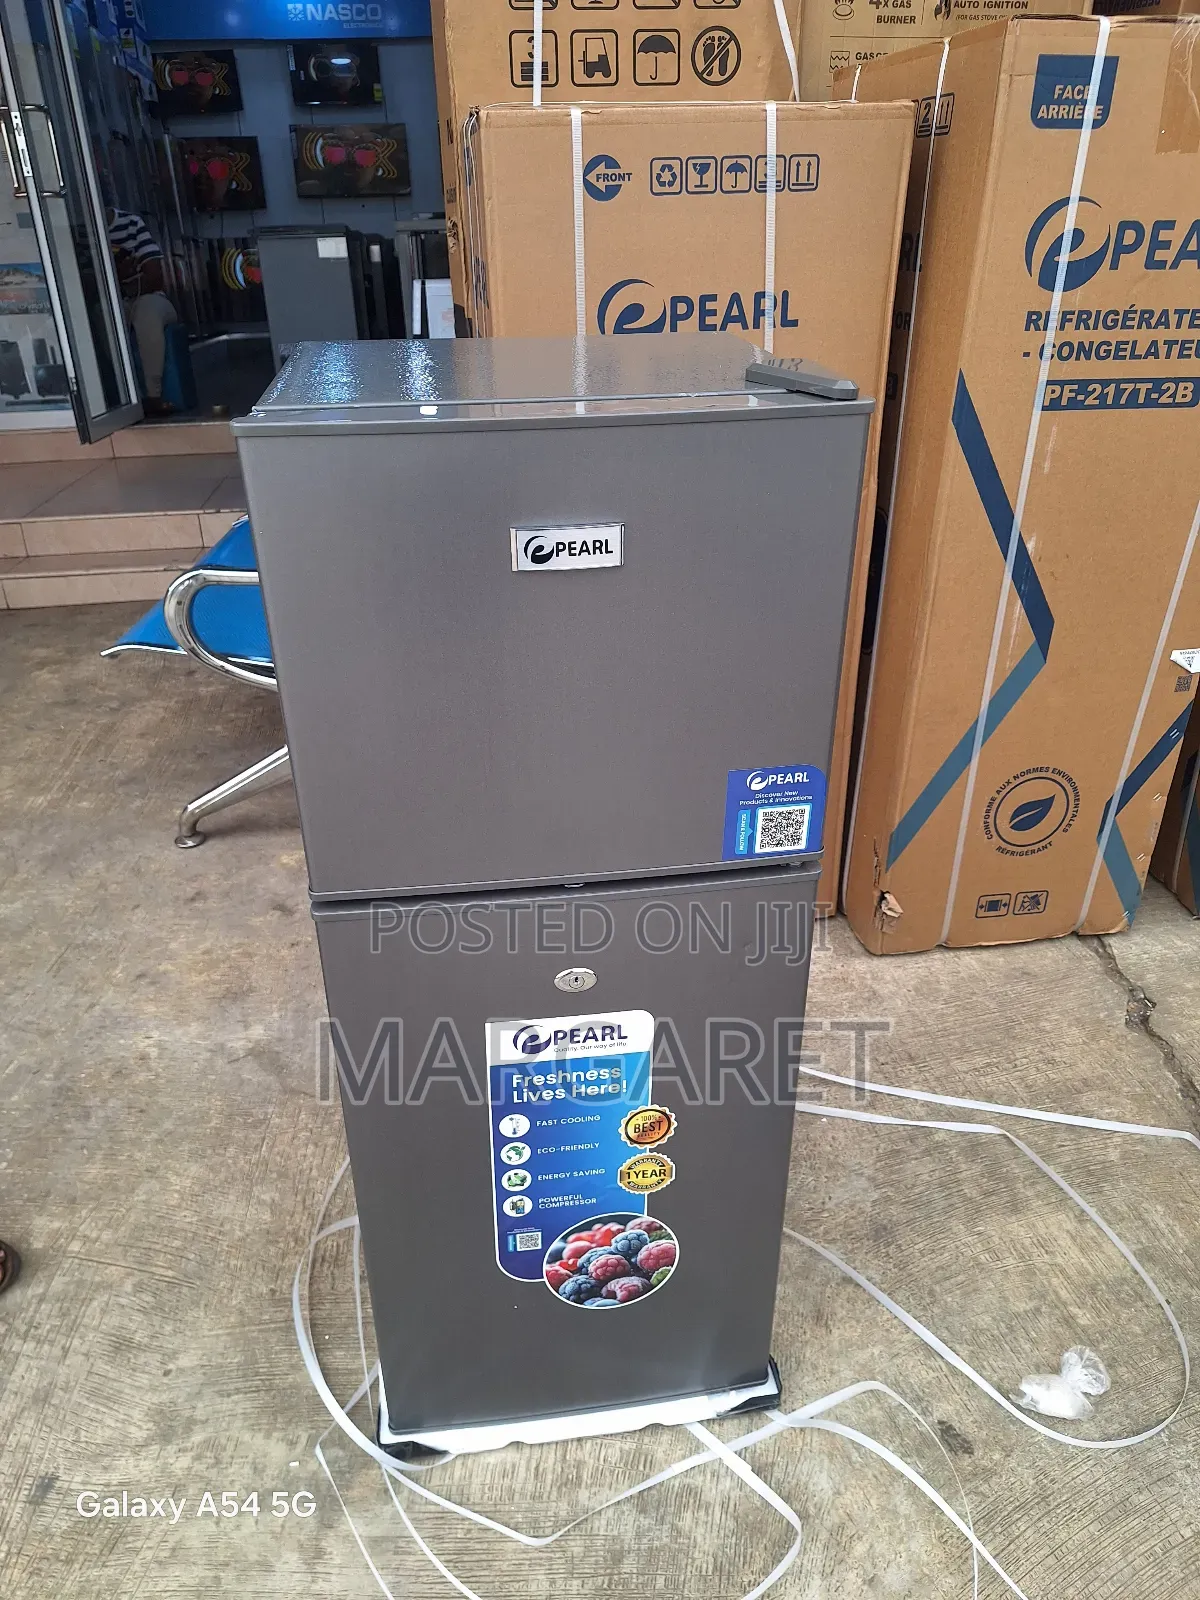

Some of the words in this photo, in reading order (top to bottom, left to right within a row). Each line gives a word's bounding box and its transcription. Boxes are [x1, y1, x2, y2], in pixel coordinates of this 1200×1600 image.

[892, 0, 912, 8] GAS
[953, 0, 980, 8] AUTO
[983, 1, 1029, 9] IGNITION
[305, 3, 382, 20] NASCO
[876, 15, 916, 24] BURNER
[855, 52, 889, 60] GAS
[1037, 101, 1104, 119] ARRIÈE
[596, 172, 632, 183] FRONT
[669, 289, 799, 333] PEARL
[1043, 381, 1195, 407] PF-217T-2B
[555, 538, 614, 558] PEARL
[768, 771, 809, 786] PEARL
[755, 791, 783, 799] Discover
[775, 795, 813, 803] Innovations
[983, 796, 998, 840] CONFORME
[995, 778, 1013, 796] AUX
[1012, 766, 1051, 781] NORMES
[553, 1024, 628, 1046] PEARL
[512, 1067, 622, 1088] Freshness
[513, 1088, 566, 1104] Lives
[571, 1079, 627, 1098] Here!
[536, 1119, 558, 1127] FAST
[560, 1115, 601, 1125] COOLING
[633, 1120, 664, 1134] BEST
[537, 1142, 600, 1155] ECO-FRIENDLY
[538, 1172, 571, 1181] ENERGY
[573, 1168, 606, 1177] SAVING
[625, 1171, 631, 1180] 1
[633, 1168, 667, 1179] YEAR
[538, 1194, 583, 1204] POWERFUL
[538, 1198, 597, 1209] COMPRESSOR
